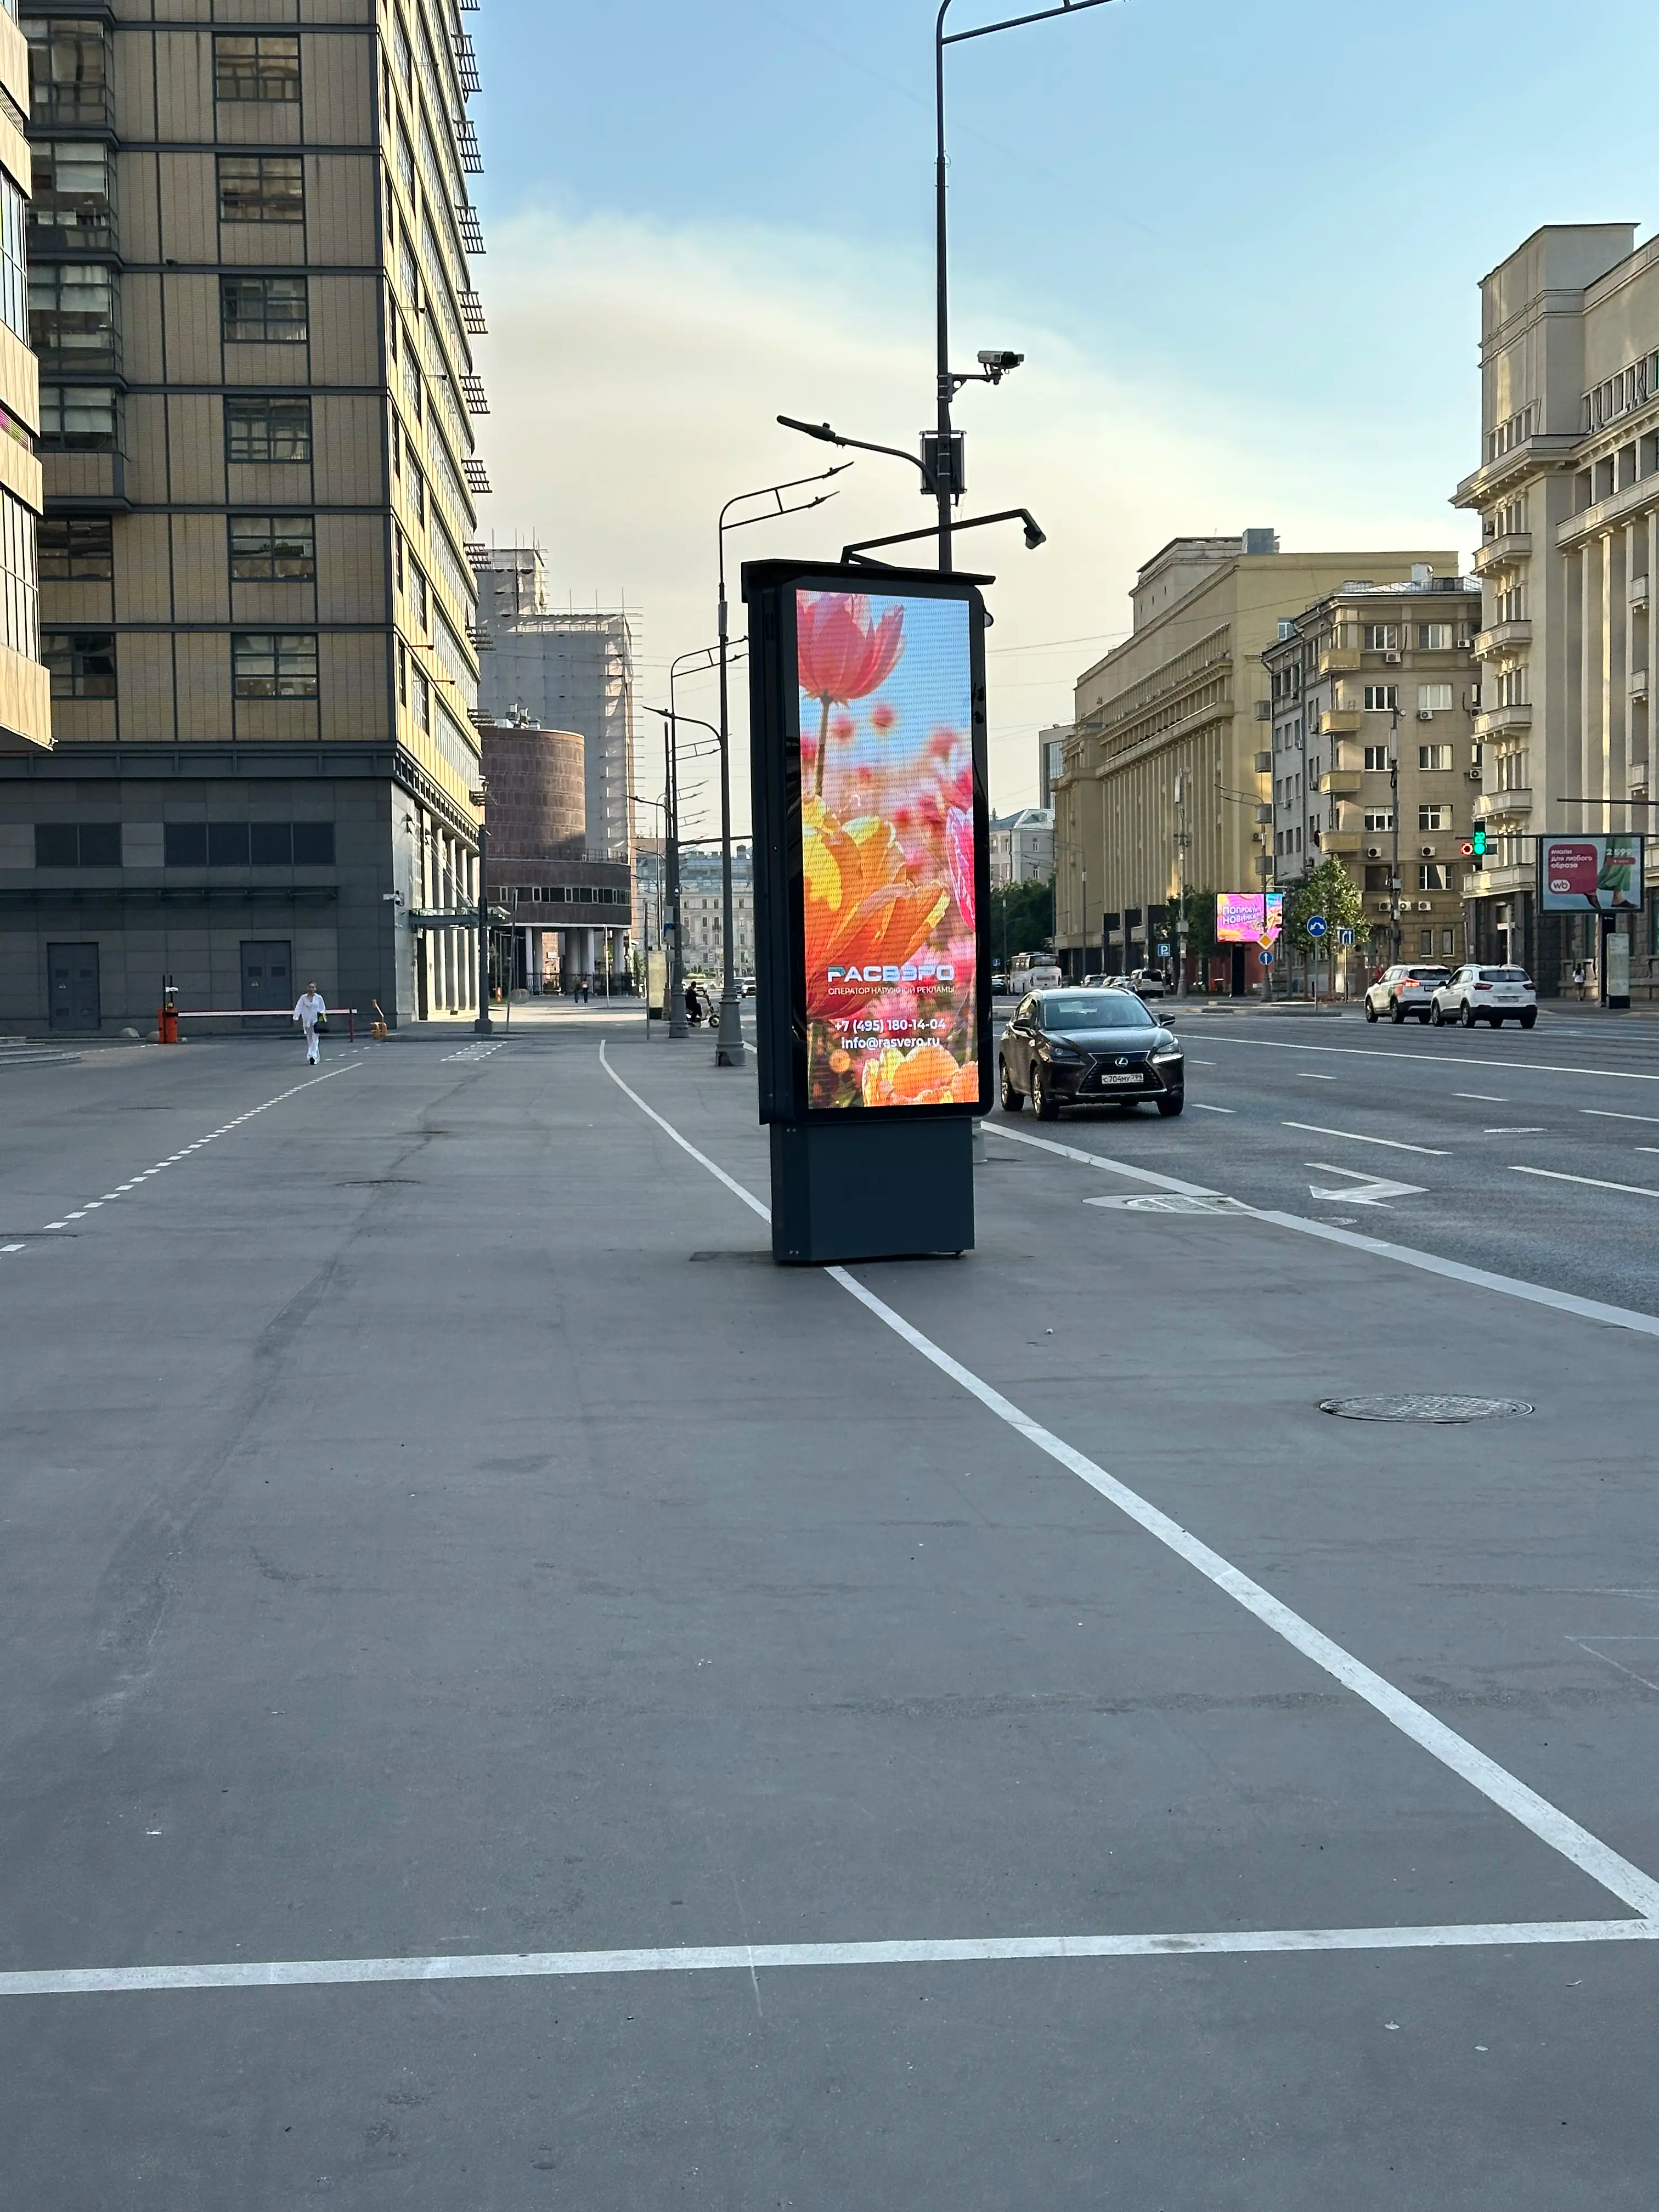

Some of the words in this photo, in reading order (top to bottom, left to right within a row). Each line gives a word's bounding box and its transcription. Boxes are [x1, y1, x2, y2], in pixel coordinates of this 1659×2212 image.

[1553, 881, 1568, 889] wb
[827, 965, 955, 983] РАСВЭРО
[828, 987, 869, 995] ОПЕРАТОР
[834, 1020, 849, 1032] +7
[853, 1019, 884, 1034] (495)
[887, 1018, 947, 1031] 180-14-04
[841, 1036, 940, 1051] info@rasvero.ru
